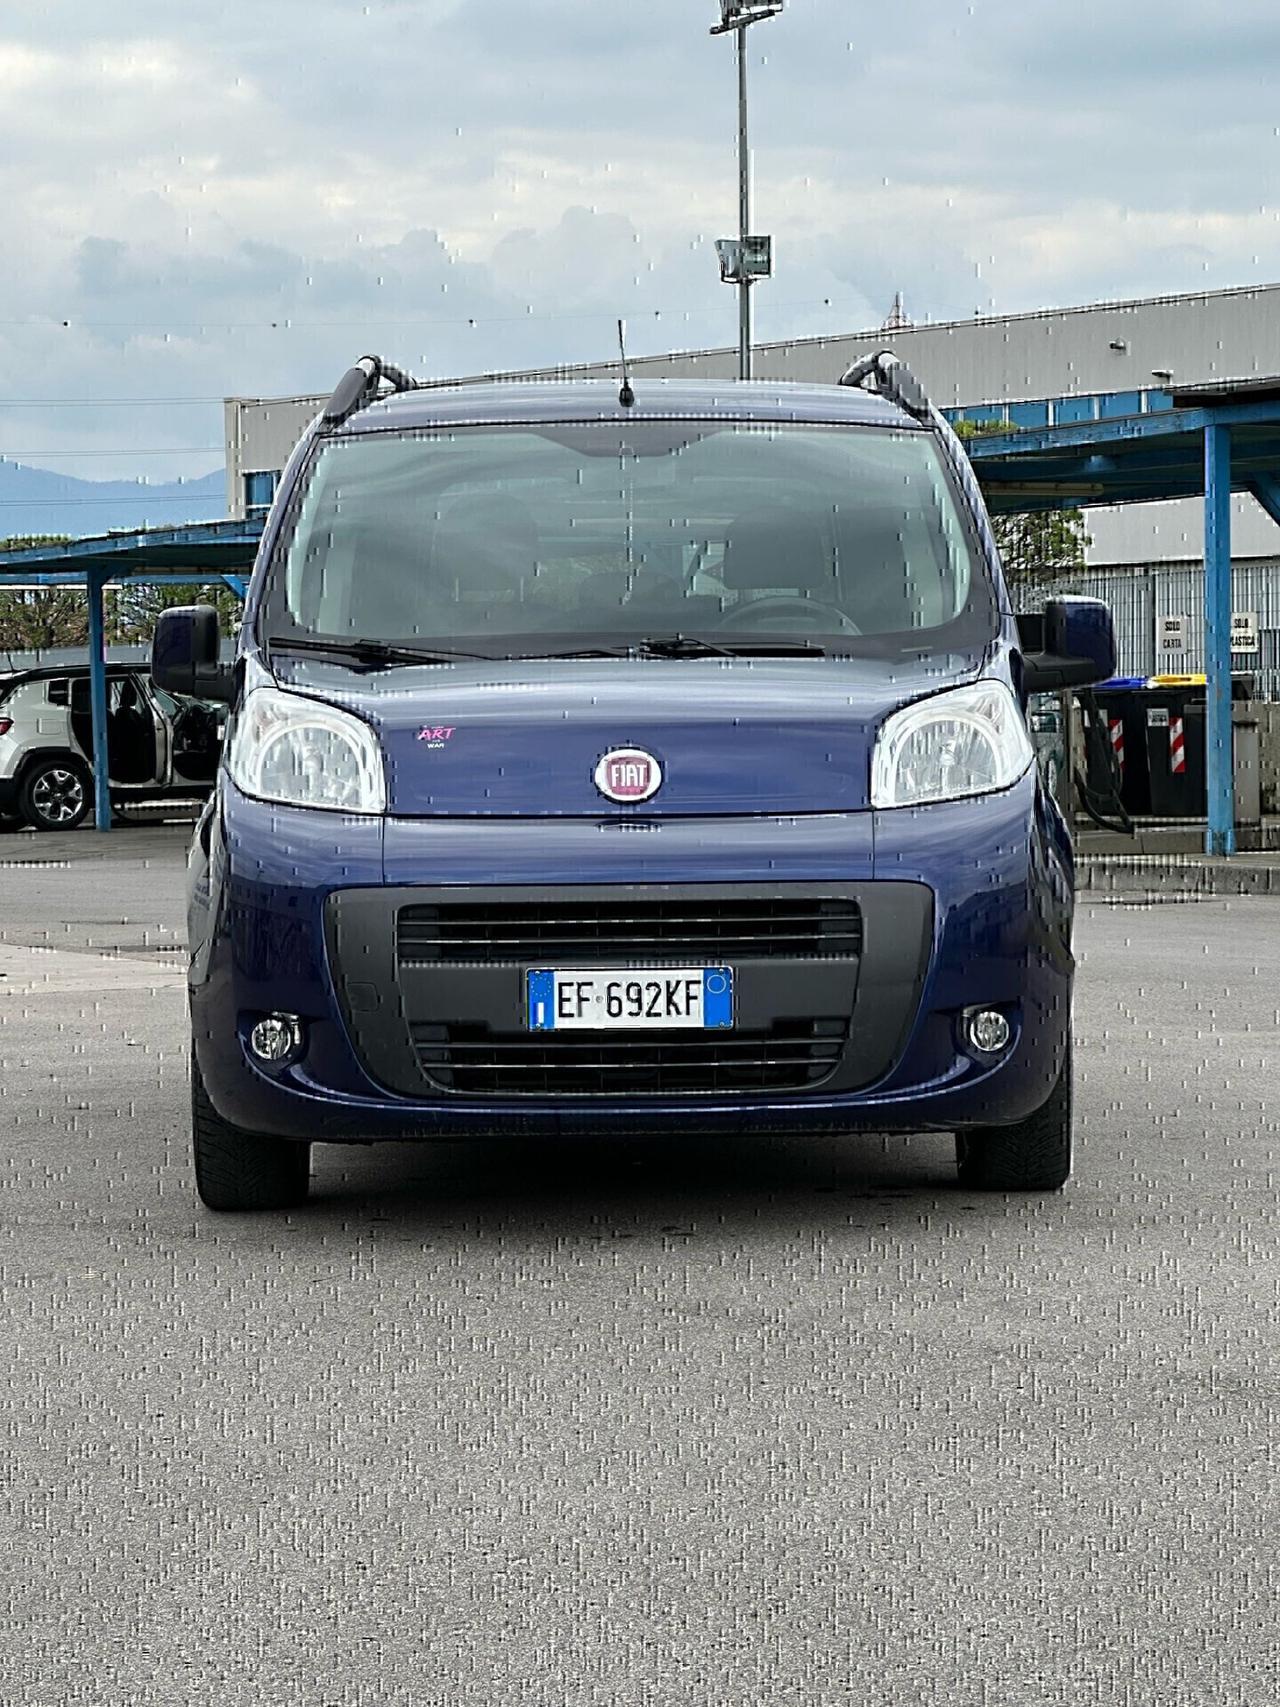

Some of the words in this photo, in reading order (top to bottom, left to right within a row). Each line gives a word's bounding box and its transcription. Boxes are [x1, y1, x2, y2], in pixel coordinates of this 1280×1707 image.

[1165, 621, 1181, 631] SOLO
[1234, 618, 1249, 629] SOLO
[1163, 639, 1181, 649] CARTA
[417, 728, 456, 741] ART
[611, 764, 647, 788] FIAT
[558, 981, 593, 1018] EF
[606, 980, 701, 1018] 692KF
